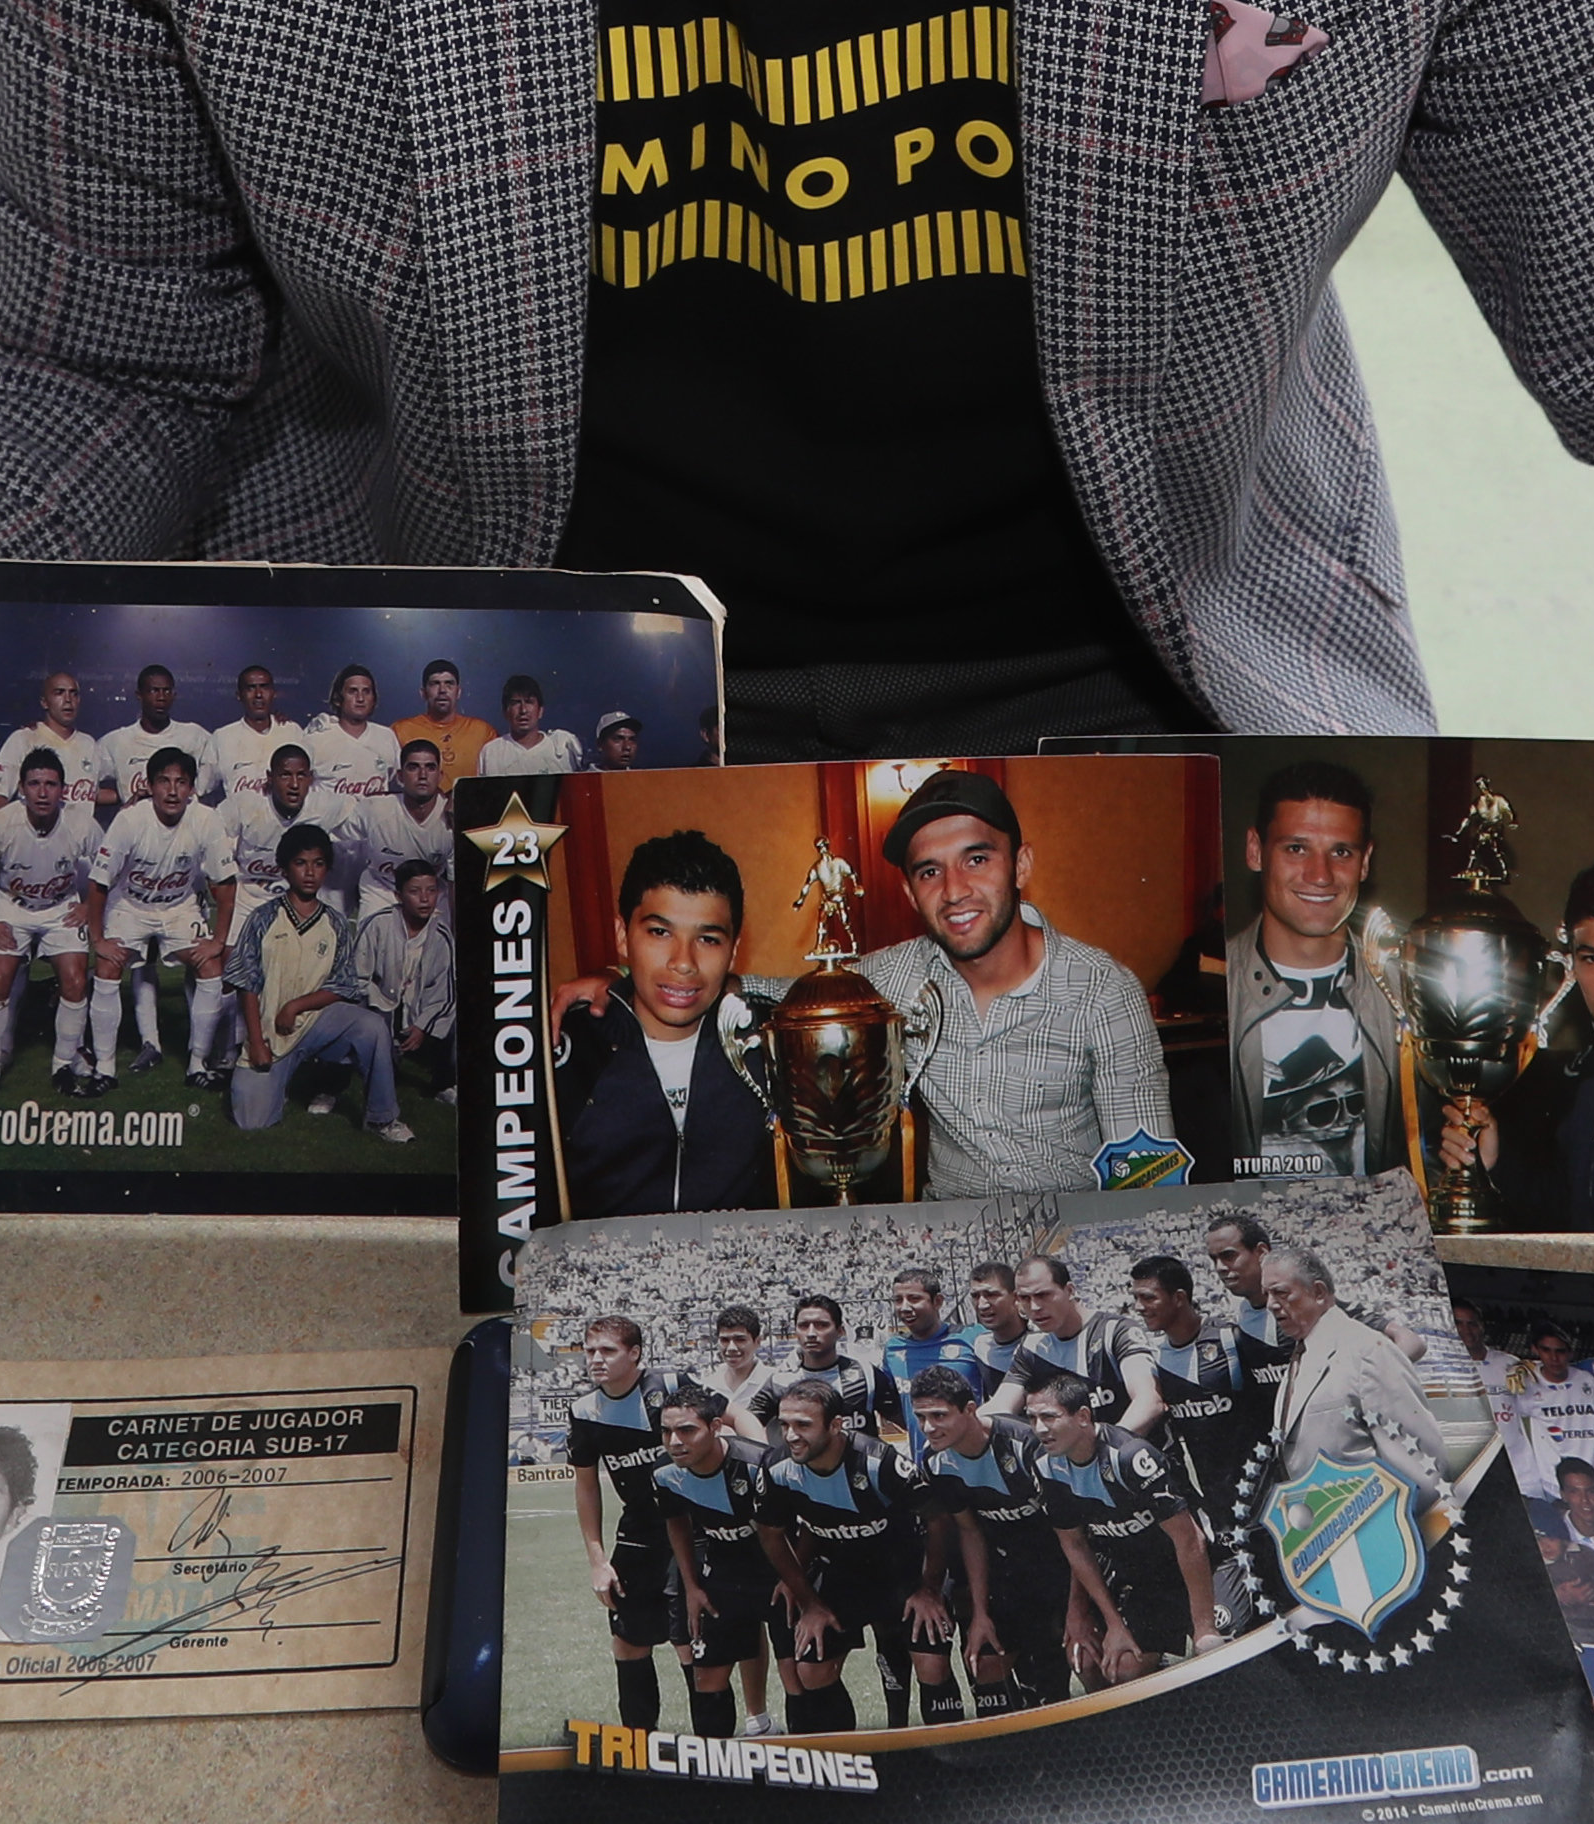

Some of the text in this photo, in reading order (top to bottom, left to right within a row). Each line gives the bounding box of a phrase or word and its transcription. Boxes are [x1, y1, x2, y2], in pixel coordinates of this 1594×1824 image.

[492, 830, 539, 866] 23
[1283, 1155, 1322, 1175] 2010
[107, 1409, 365, 1437] CARNET DE JUGADOR
[117, 1434, 350, 1461] CATEGORIA SUB-17
[56, 1466, 288, 1492] TEMPORADA: 2006-2007
[517, 1465, 575, 1483] Bantrab
[1292, 1476, 1385, 1579] COMUNICACIONES
[169, 1636, 229, 1649] Gerente
[6, 1655, 61, 1676] Oficial
[66, 1654, 158, 1675] 2006-2007
[931, 1694, 1007, 1712] Julio 2013
[568, 1719, 880, 1791] TRICAMPEONES
[1378, 1805, 1409, 1820] 2014
[1420, 1794, 1544, 1817] CamerinoCrema.com
